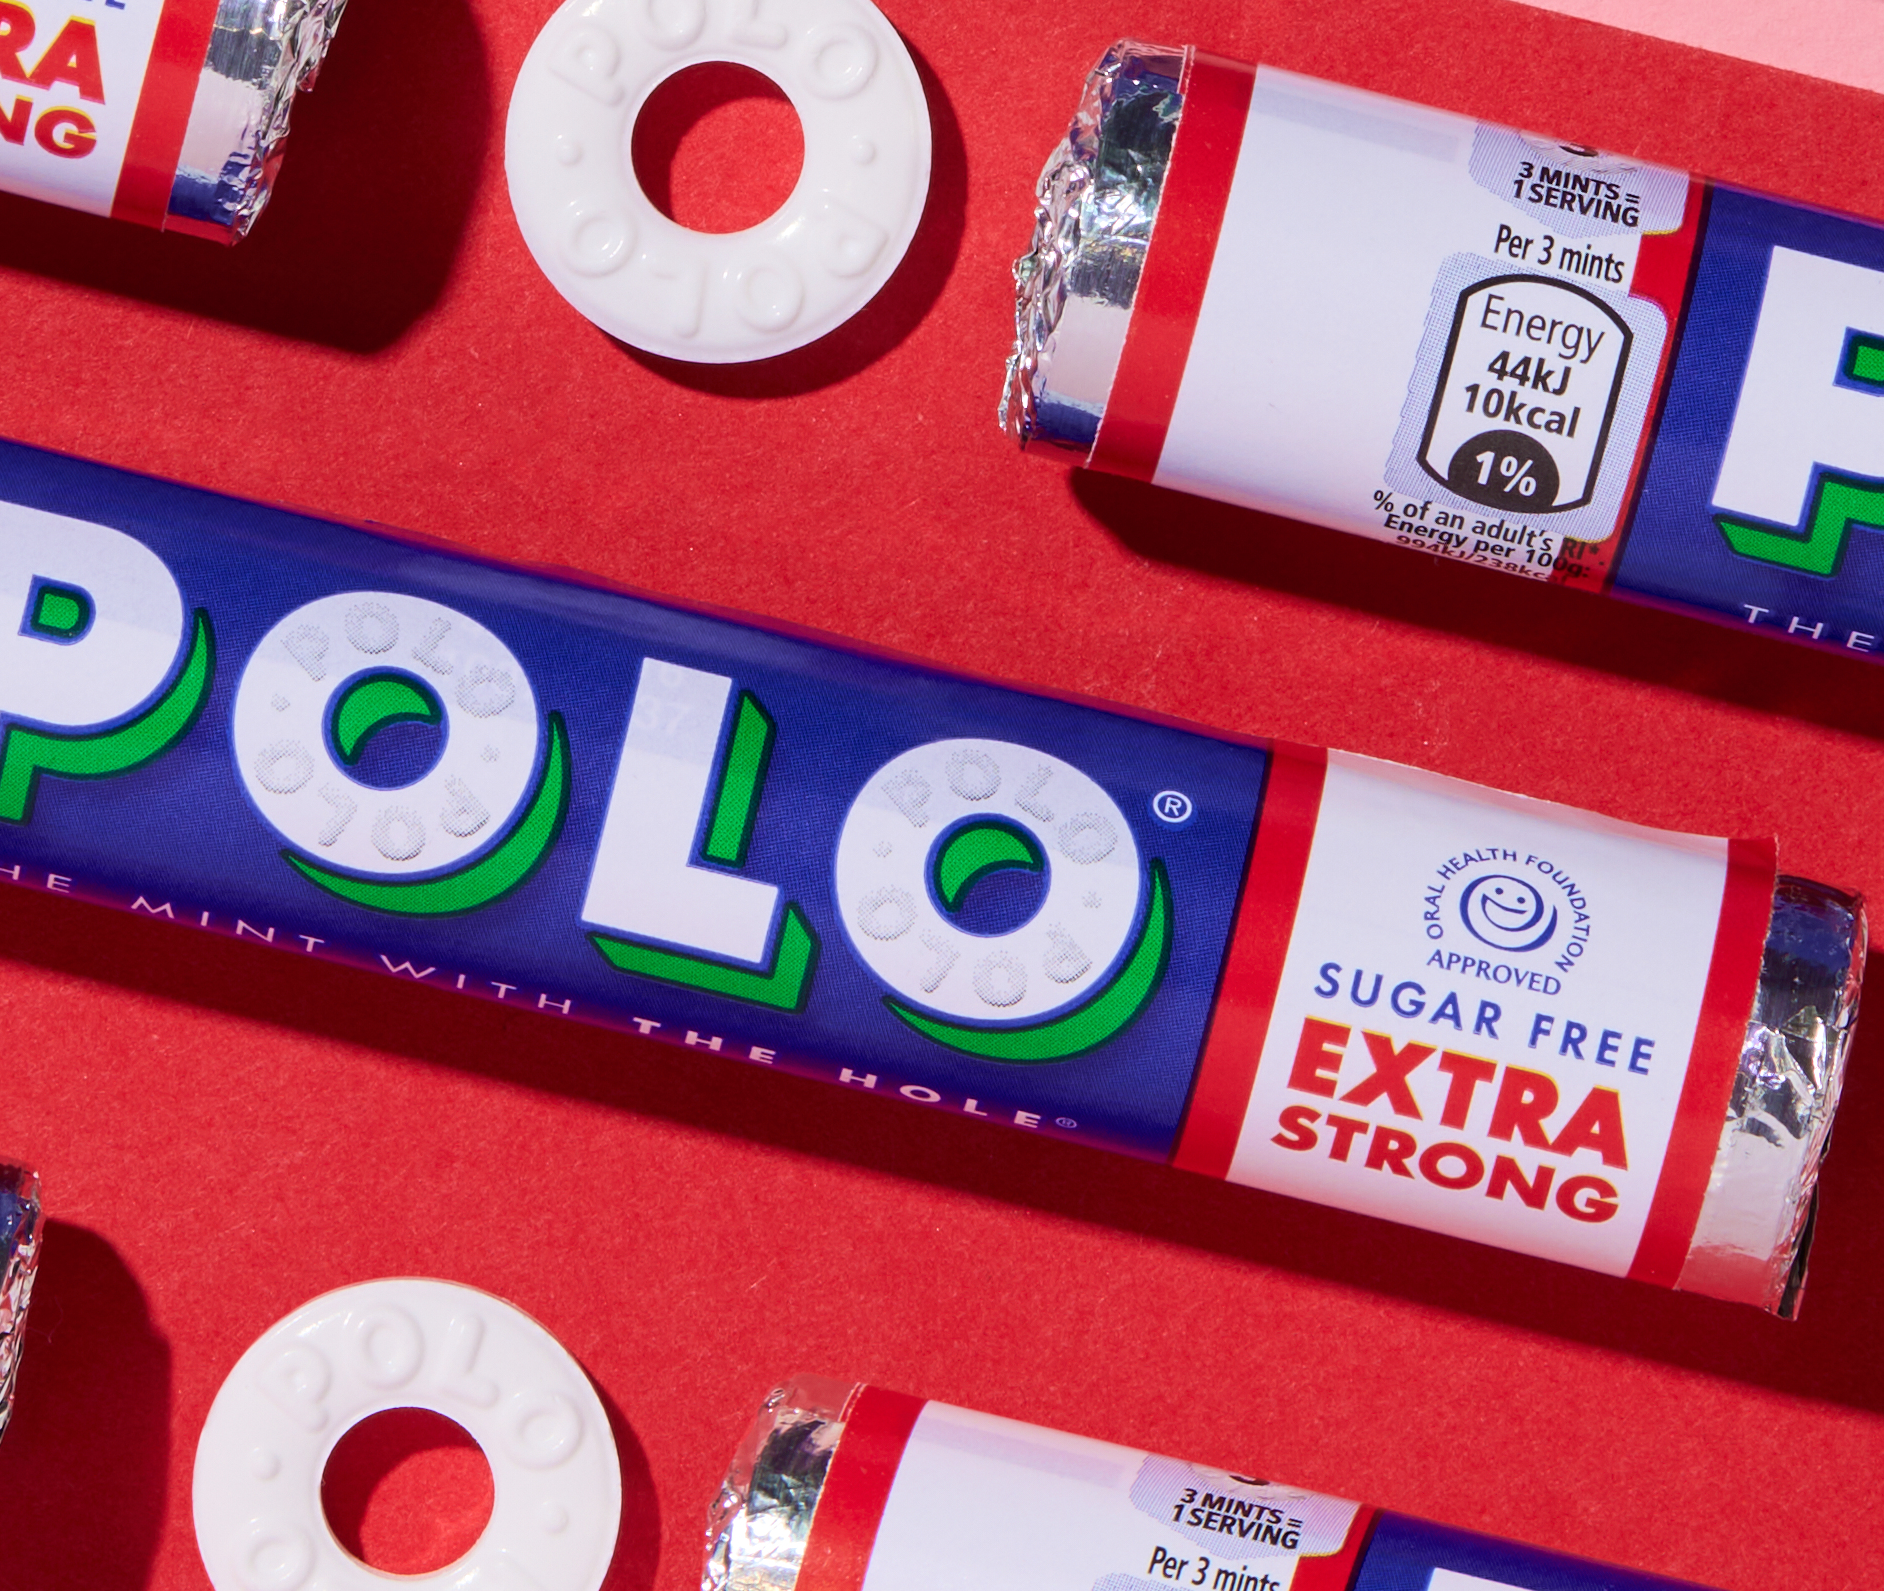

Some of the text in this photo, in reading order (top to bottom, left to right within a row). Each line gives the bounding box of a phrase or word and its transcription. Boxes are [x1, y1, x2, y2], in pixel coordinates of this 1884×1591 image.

[1513, 179, 1639, 228] 1 SERVING
[1519, 161, 1534, 179] 3
[1539, 166, 1620, 201] MINTS
[1494, 224, 1625, 284] Per 3 mints
[1480, 293, 1605, 365] Energy
[1487, 350, 1571, 396] 44kJ
[1465, 383, 1581, 438] 10kcal
[1476, 450, 1537, 496] 1%
[1373, 489, 1394, 513] %
[1402, 500, 1432, 521] of
[1434, 511, 1465, 530] an
[1383, 513, 1468, 549] Energy
[1472, 539, 1515, 558] per
[131, 896, 324, 952] MINT
[380, 954, 571, 1015] WITH
[633, 1017, 776, 1064] THE
[1426, 948, 1561, 995] APPROVED
[1314, 962, 1655, 1075] SUGAR FREE
[1288, 1015, 1629, 1170] EXTRA
[1271, 1104, 1619, 1224] STRONG
[1173, 1503, 1300, 1550] 1 SERVING
[1181, 1487, 1198, 1504] 3
[1201, 1492, 1284, 1525] MINTS
